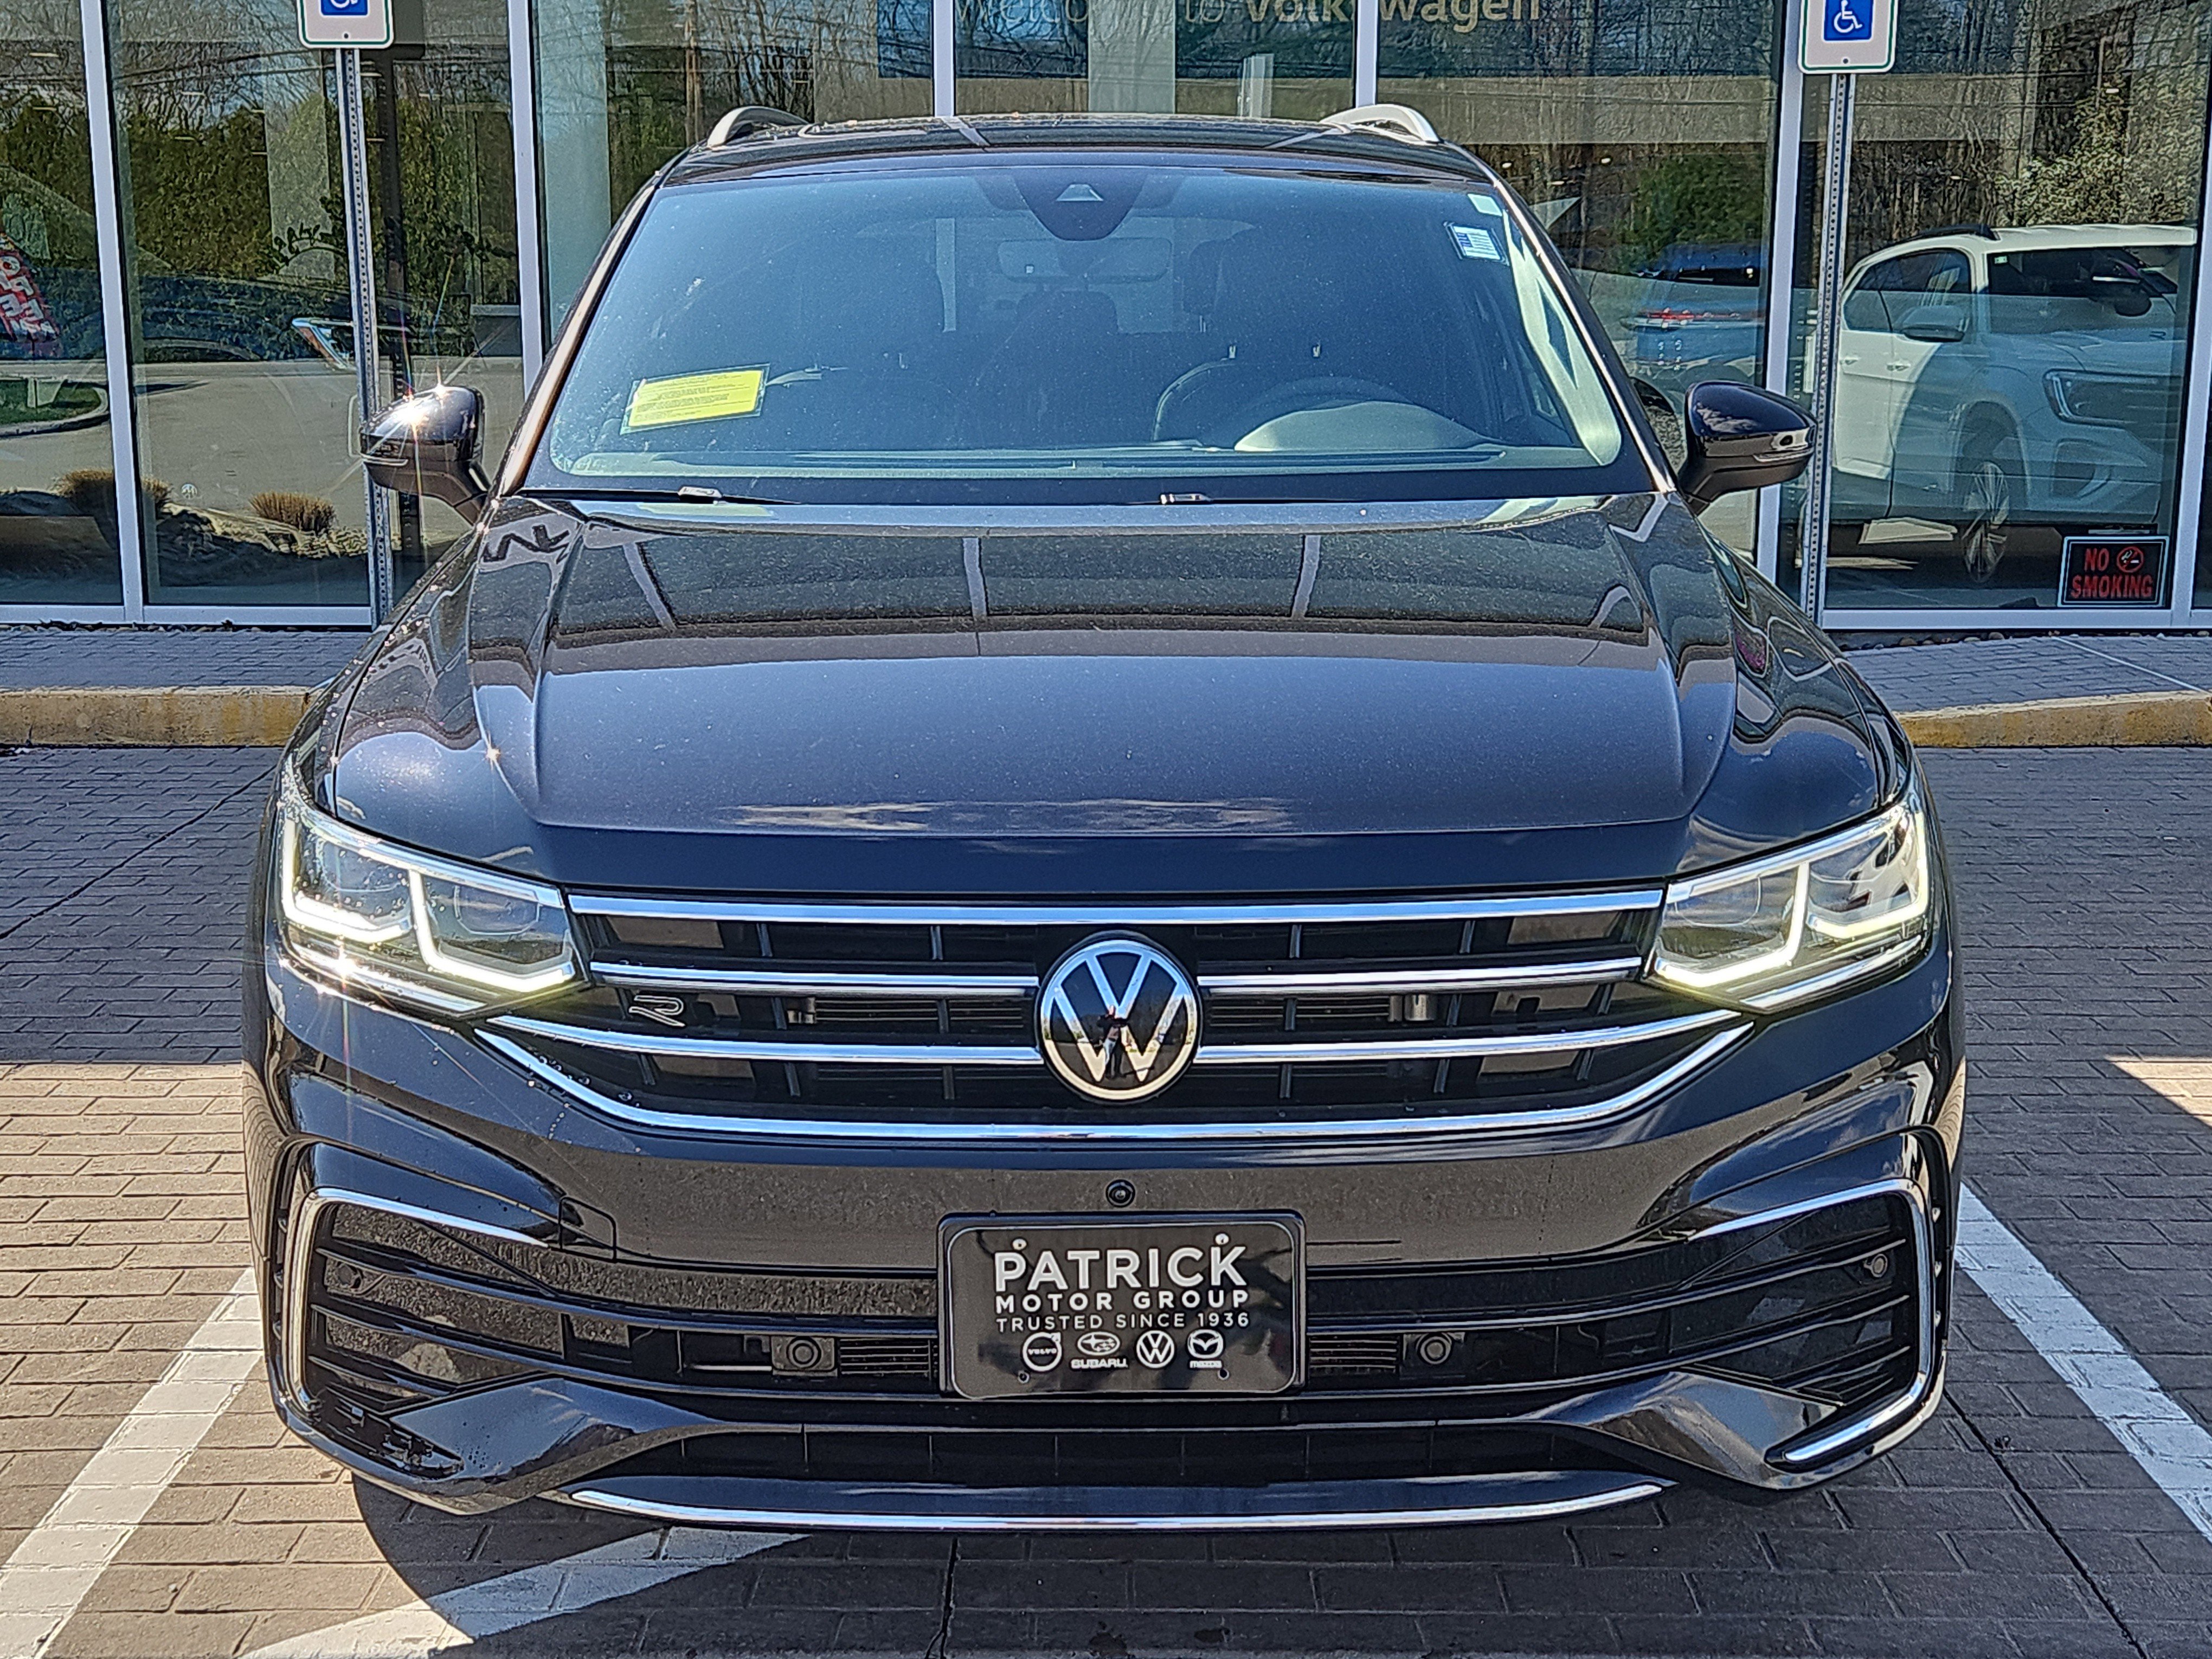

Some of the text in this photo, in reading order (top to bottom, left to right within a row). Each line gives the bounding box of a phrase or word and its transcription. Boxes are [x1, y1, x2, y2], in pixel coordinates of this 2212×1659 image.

[1247, 0, 1540, 33] Volkwagen
[2085, 548, 2110, 571] NO
[2070, 575, 2153, 599] SMOKING
[629, 995, 685, 1027] R
[994, 1246, 1248, 1293] PATRICK
[995, 1289, 1248, 1314] MOTOR GROUP
[996, 1311, 1249, 1333] TRUSTED SINCE 1936
[1071, 1358, 1128, 1369] SUBARU
